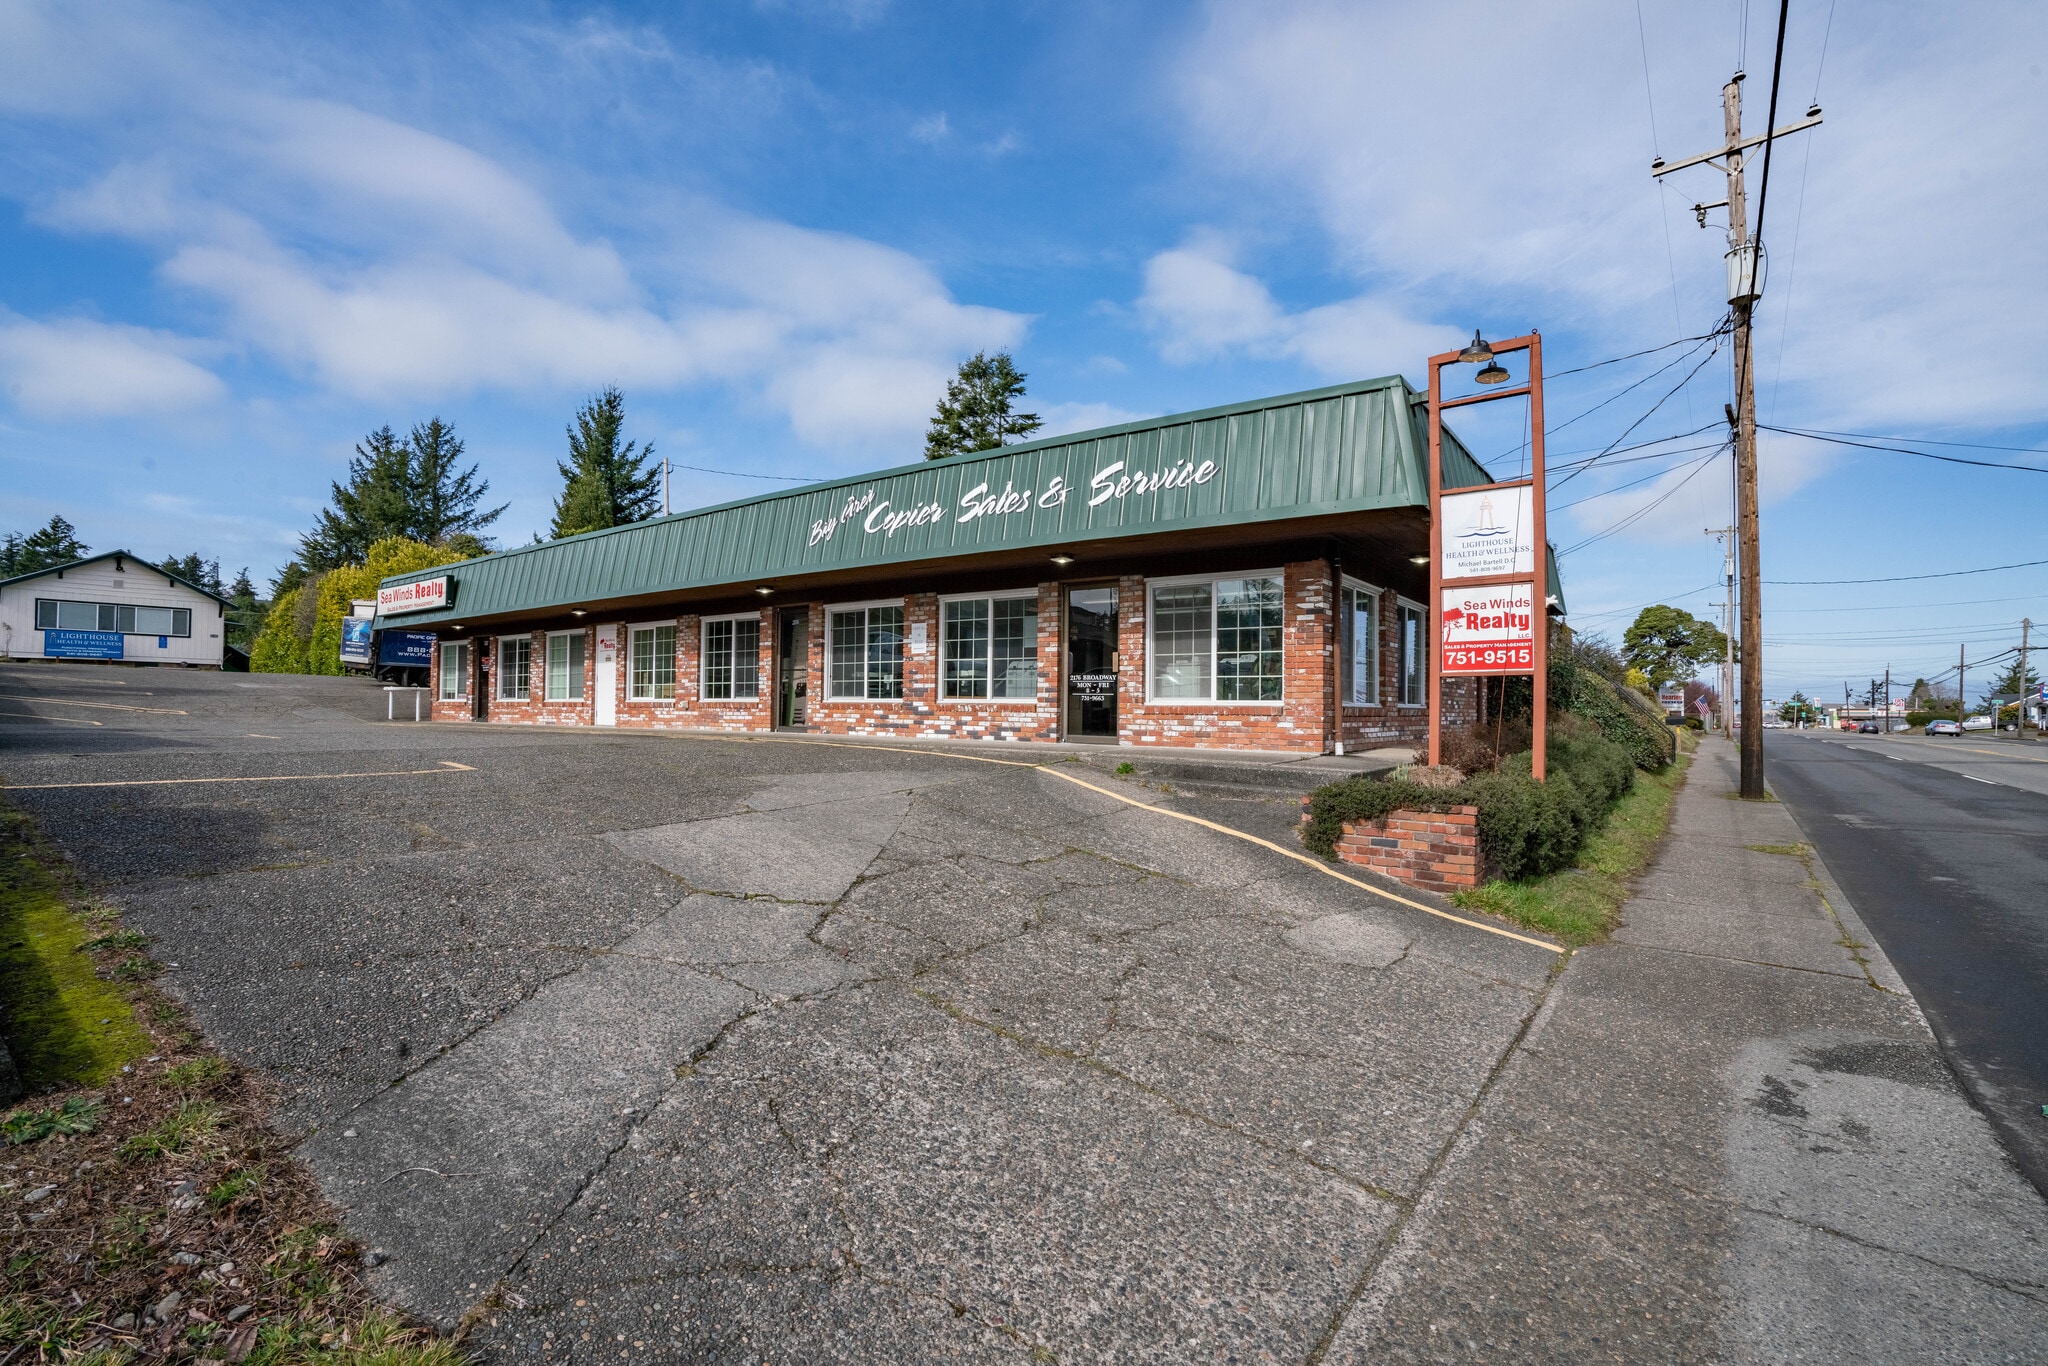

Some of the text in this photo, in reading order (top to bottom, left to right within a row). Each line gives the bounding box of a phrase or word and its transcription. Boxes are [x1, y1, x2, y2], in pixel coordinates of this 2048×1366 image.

[864, 501, 948, 538] Copier
[957, 481, 1032, 523] Sales
[1038, 476, 1075, 509] &
[1088, 459, 1220, 506] Service
[1462, 538, 1514, 549] LIGHTHOUSE
[1446, 549, 1478, 559] HEALTH
[1486, 545, 1530, 555] WELLNESS
[381, 581, 443, 604] Sea Winds Realty
[1464, 597, 1530, 610] Sea Winds
[1466, 611, 1530, 631] Realty
[60, 632, 120, 641] LIGHTHOUSE
[1446, 649, 1530, 665] 751-9515
